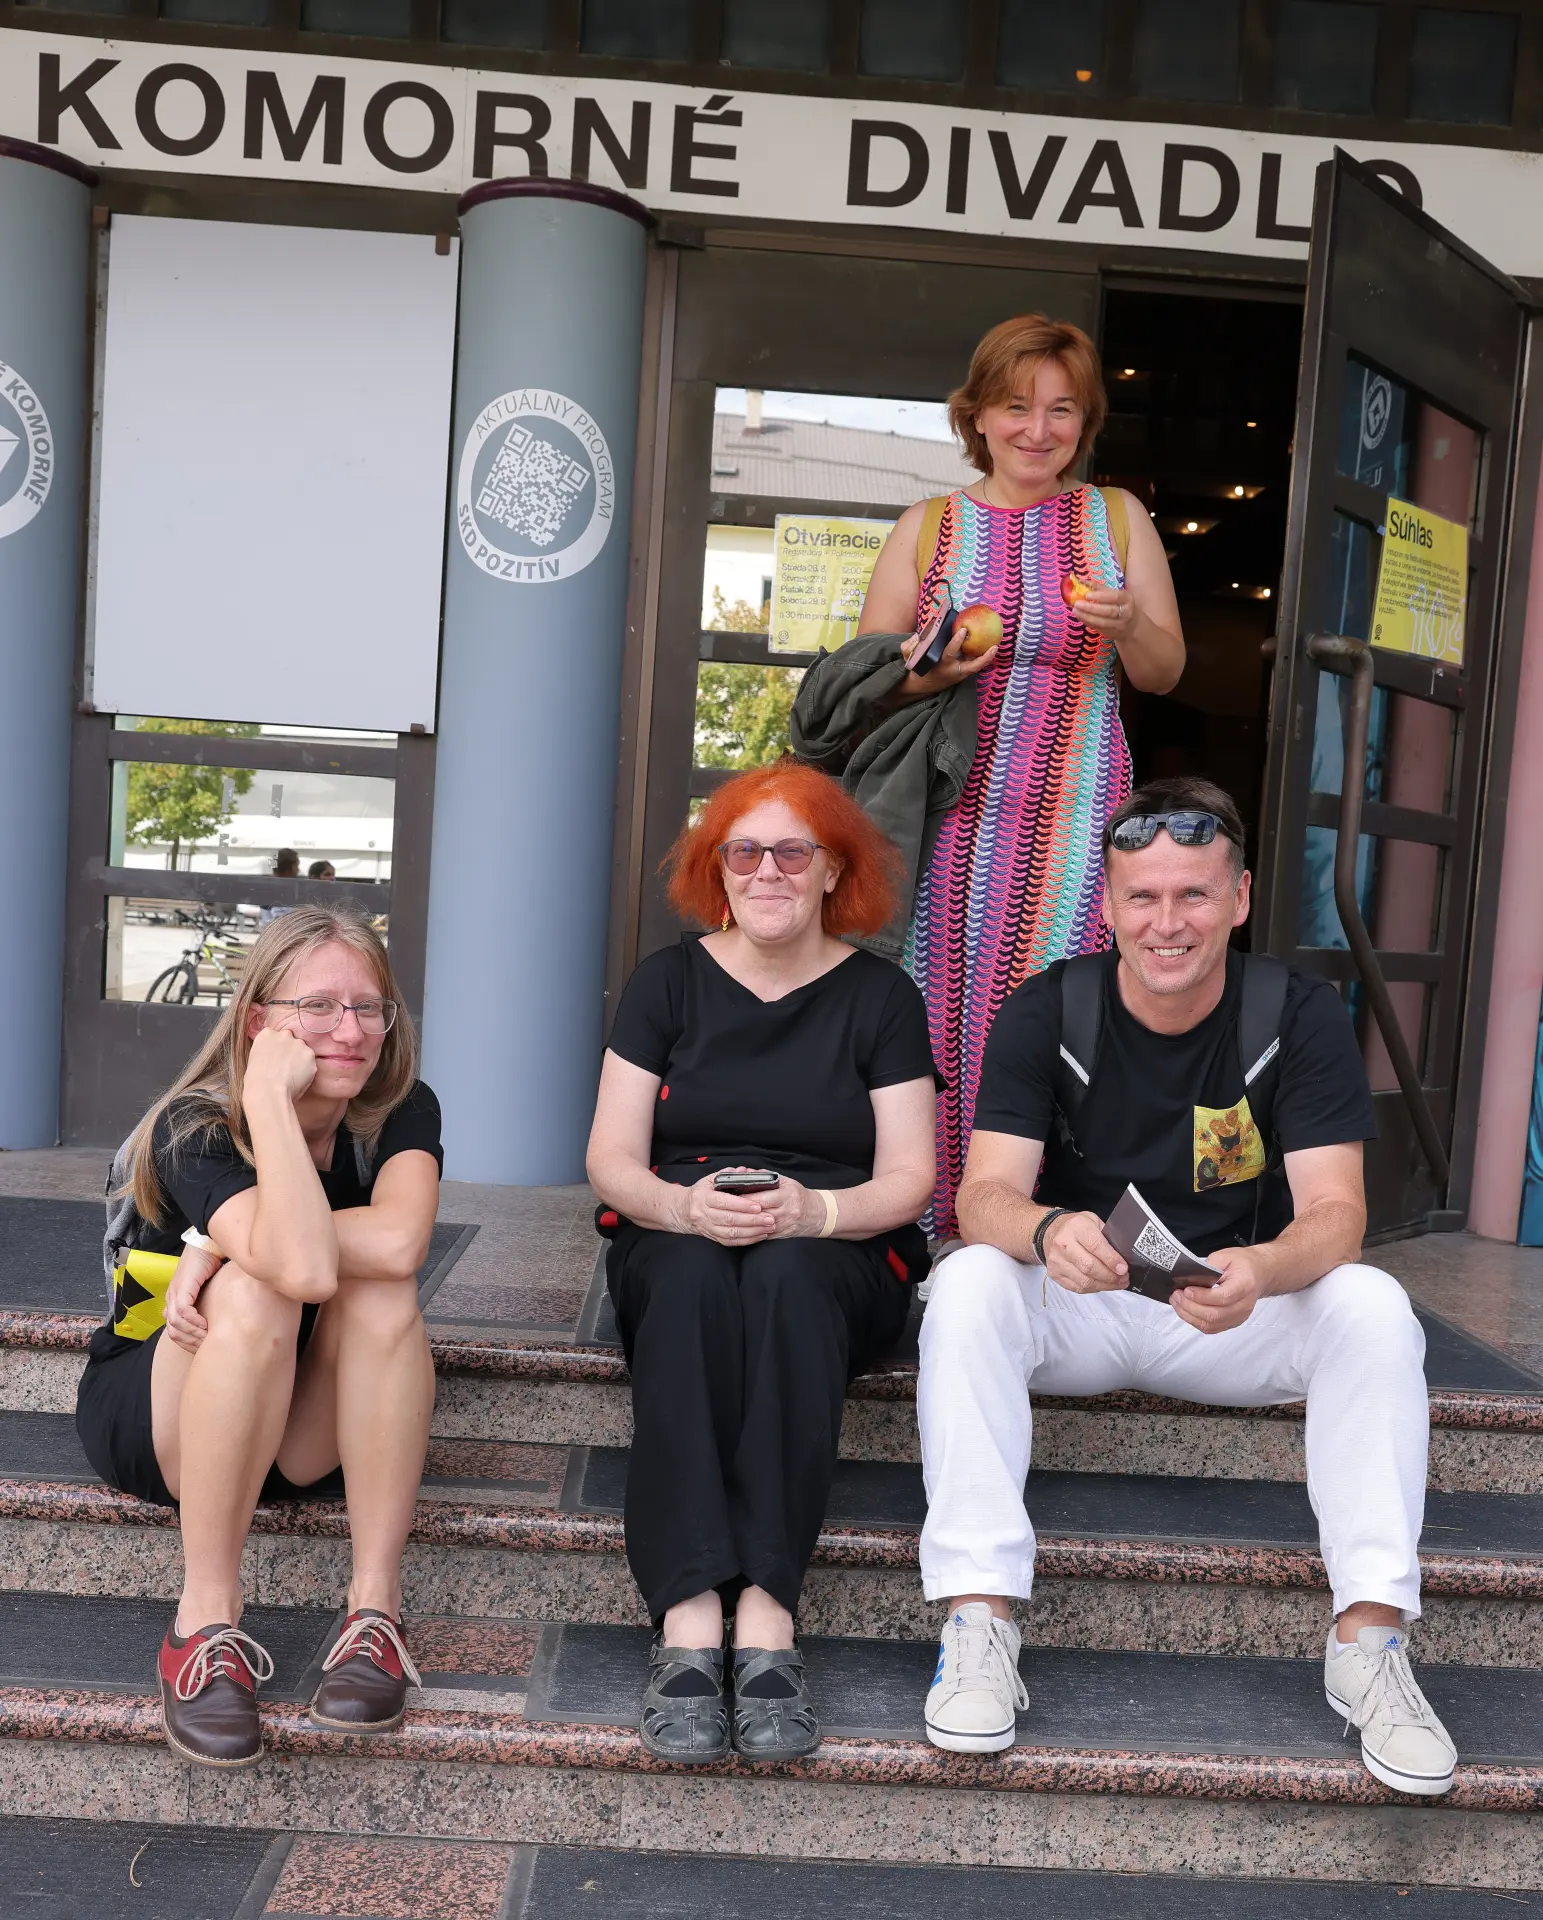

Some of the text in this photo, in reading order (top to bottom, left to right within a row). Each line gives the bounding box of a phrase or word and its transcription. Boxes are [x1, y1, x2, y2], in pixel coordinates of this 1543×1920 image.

[38, 52, 743, 198] KOMORNÉ
[4, 378, 44, 507] KOMORNÉ
[475, 389, 613, 520] AKTUÁLNY PROGRAM
[458, 503, 560, 580] SKD POZITÍV
[784, 527, 881, 550] Otváracie
[1389, 510, 1433, 549] Súhlas
[782, 563, 807, 572] Streda
[785, 611, 796, 619] 30
[797, 612, 811, 620] min
[812, 613, 829, 623] pred
